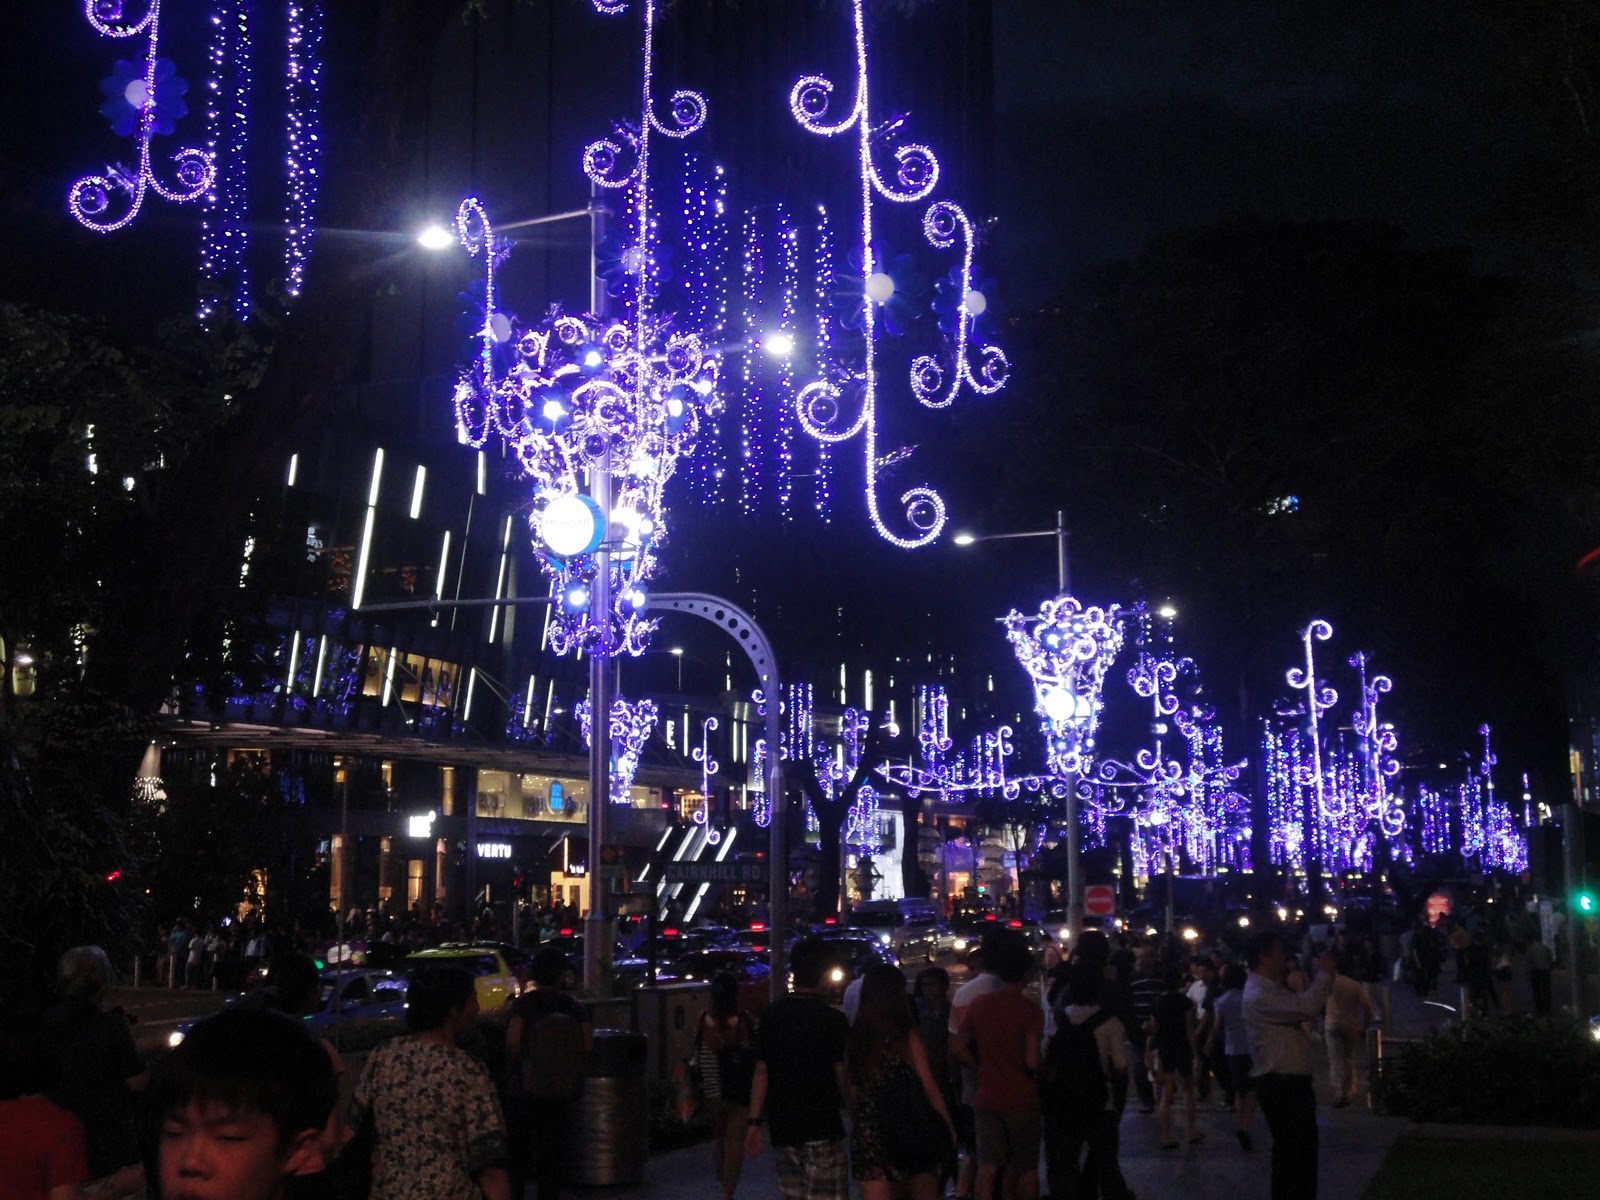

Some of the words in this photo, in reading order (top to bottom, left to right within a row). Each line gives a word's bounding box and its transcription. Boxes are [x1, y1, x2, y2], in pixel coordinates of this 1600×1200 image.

[477, 843, 512, 858] VERTU
[667, 864, 738, 880] CAIRNHILL
[742, 864, 761, 880] RD
